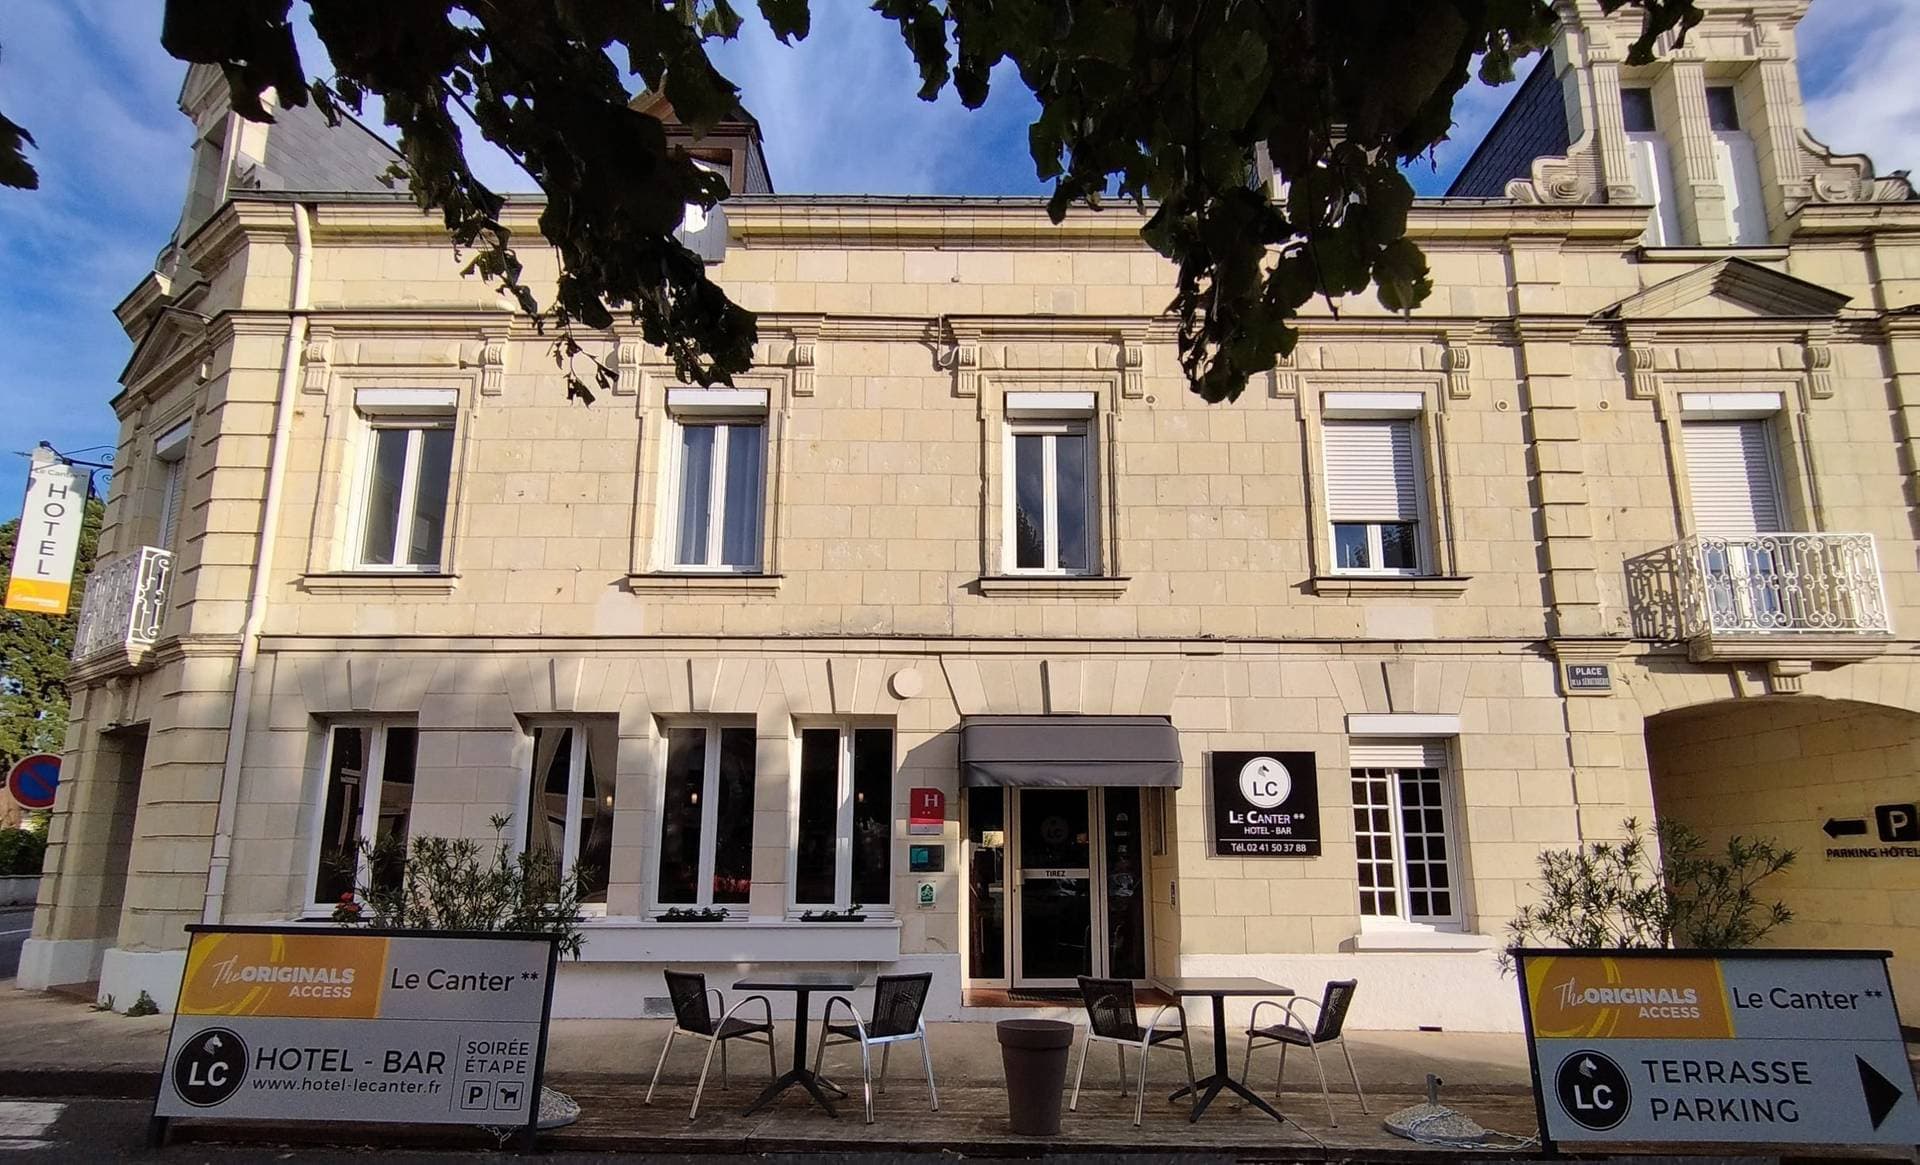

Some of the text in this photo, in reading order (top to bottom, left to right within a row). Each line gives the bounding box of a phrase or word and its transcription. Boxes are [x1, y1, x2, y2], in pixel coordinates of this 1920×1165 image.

[37, 482, 68, 576] HOTEL
[1575, 667, 1602, 676] PLACE
[1253, 781, 1278, 796] LC
[924, 794, 938, 808] H
[1244, 826, 1270, 835] HOTEL
[1275, 826, 1292, 835] BAR
[1888, 810, 1908, 838] P
[1246, 843, 1258, 852] 02
[1258, 843, 1270, 852] 41
[1271, 843, 1283, 853] 50
[1283, 843, 1294, 852] 37
[1295, 843, 1307, 853] 88
[1826, 848, 1877, 858] PARKING
[1045, 870, 1066, 878] TIREZ
[391, 967, 515, 992] Le Canter
[288, 985, 353, 999] ACCESS
[1732, 986, 1859, 1010] Le Canter
[1638, 1006, 1701, 1019] ACCESS
[466, 1038, 530, 1056] SOIRÉE
[255, 1047, 355, 1073] HOTEL
[383, 1050, 447, 1075] BAR
[465, 1056, 527, 1074] ÉTAPE
[188, 1061, 229, 1086] LC
[1641, 1059, 1812, 1085] TERRASSE
[253, 1077, 441, 1094] www.hotel-lecanter.fr
[1574, 1084, 1614, 1111] LC
[1650, 1097, 1799, 1123] PARKING
